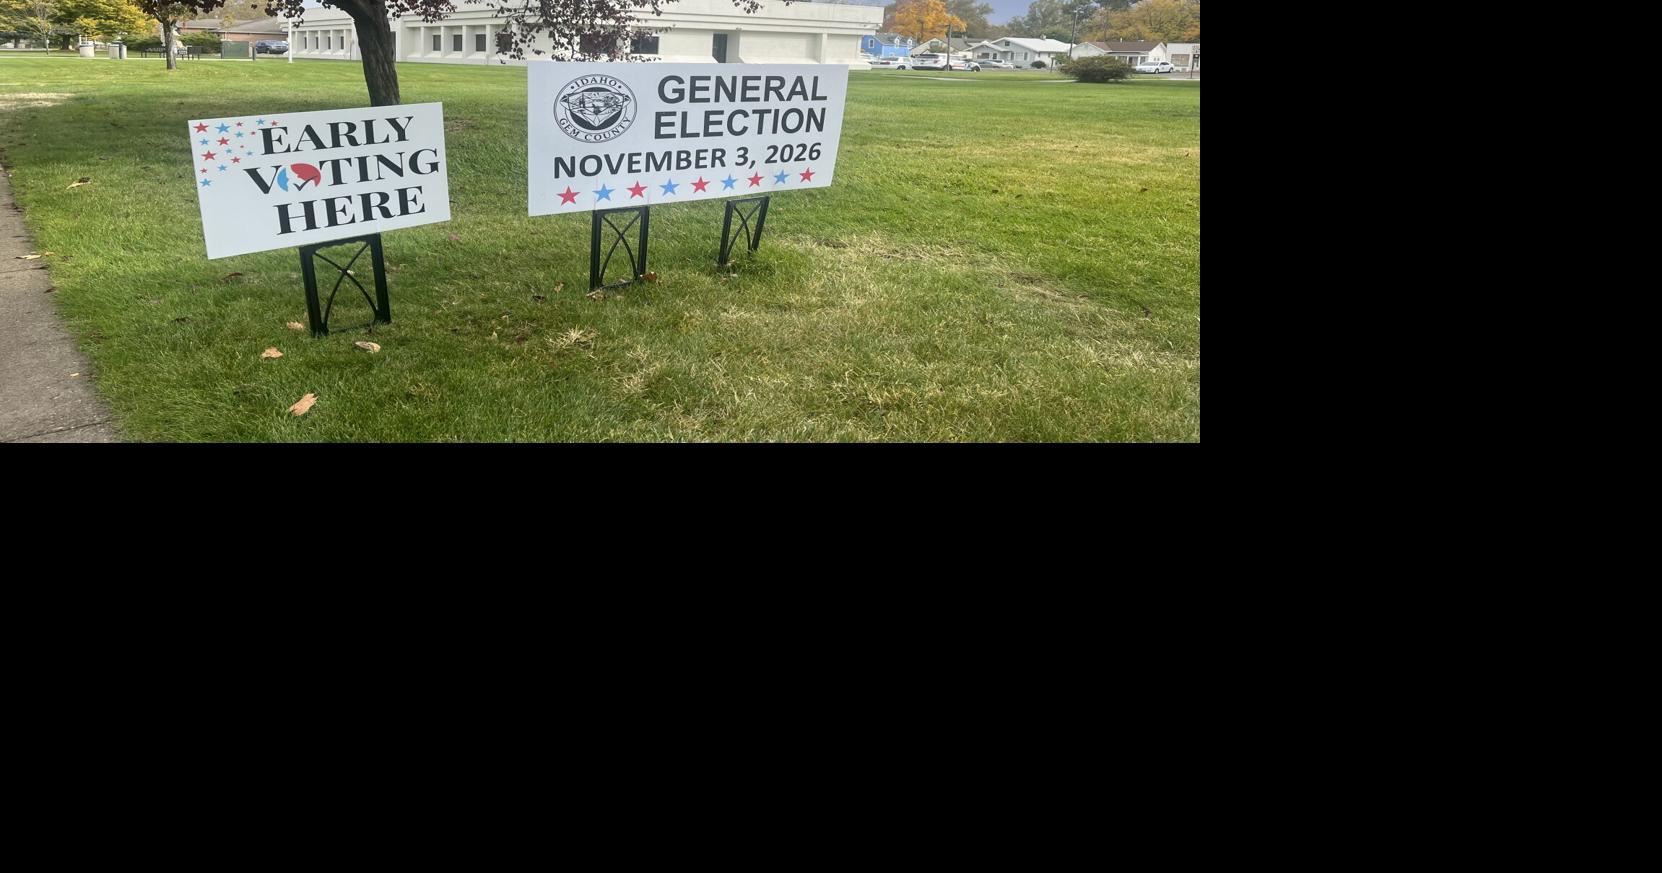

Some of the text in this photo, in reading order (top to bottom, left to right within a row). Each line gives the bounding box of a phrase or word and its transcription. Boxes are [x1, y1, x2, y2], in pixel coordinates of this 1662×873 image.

[575, 76, 617, 88] IDAHO
[657, 75, 828, 104] GENERAL
[258, 115, 415, 156] EARLY
[559, 116, 631, 141] GEM COUNTY
[654, 107, 826, 139] ELECTION
[553, 141, 822, 179] NOVEMBER 3, 2026
[273, 185, 426, 236] HERE
